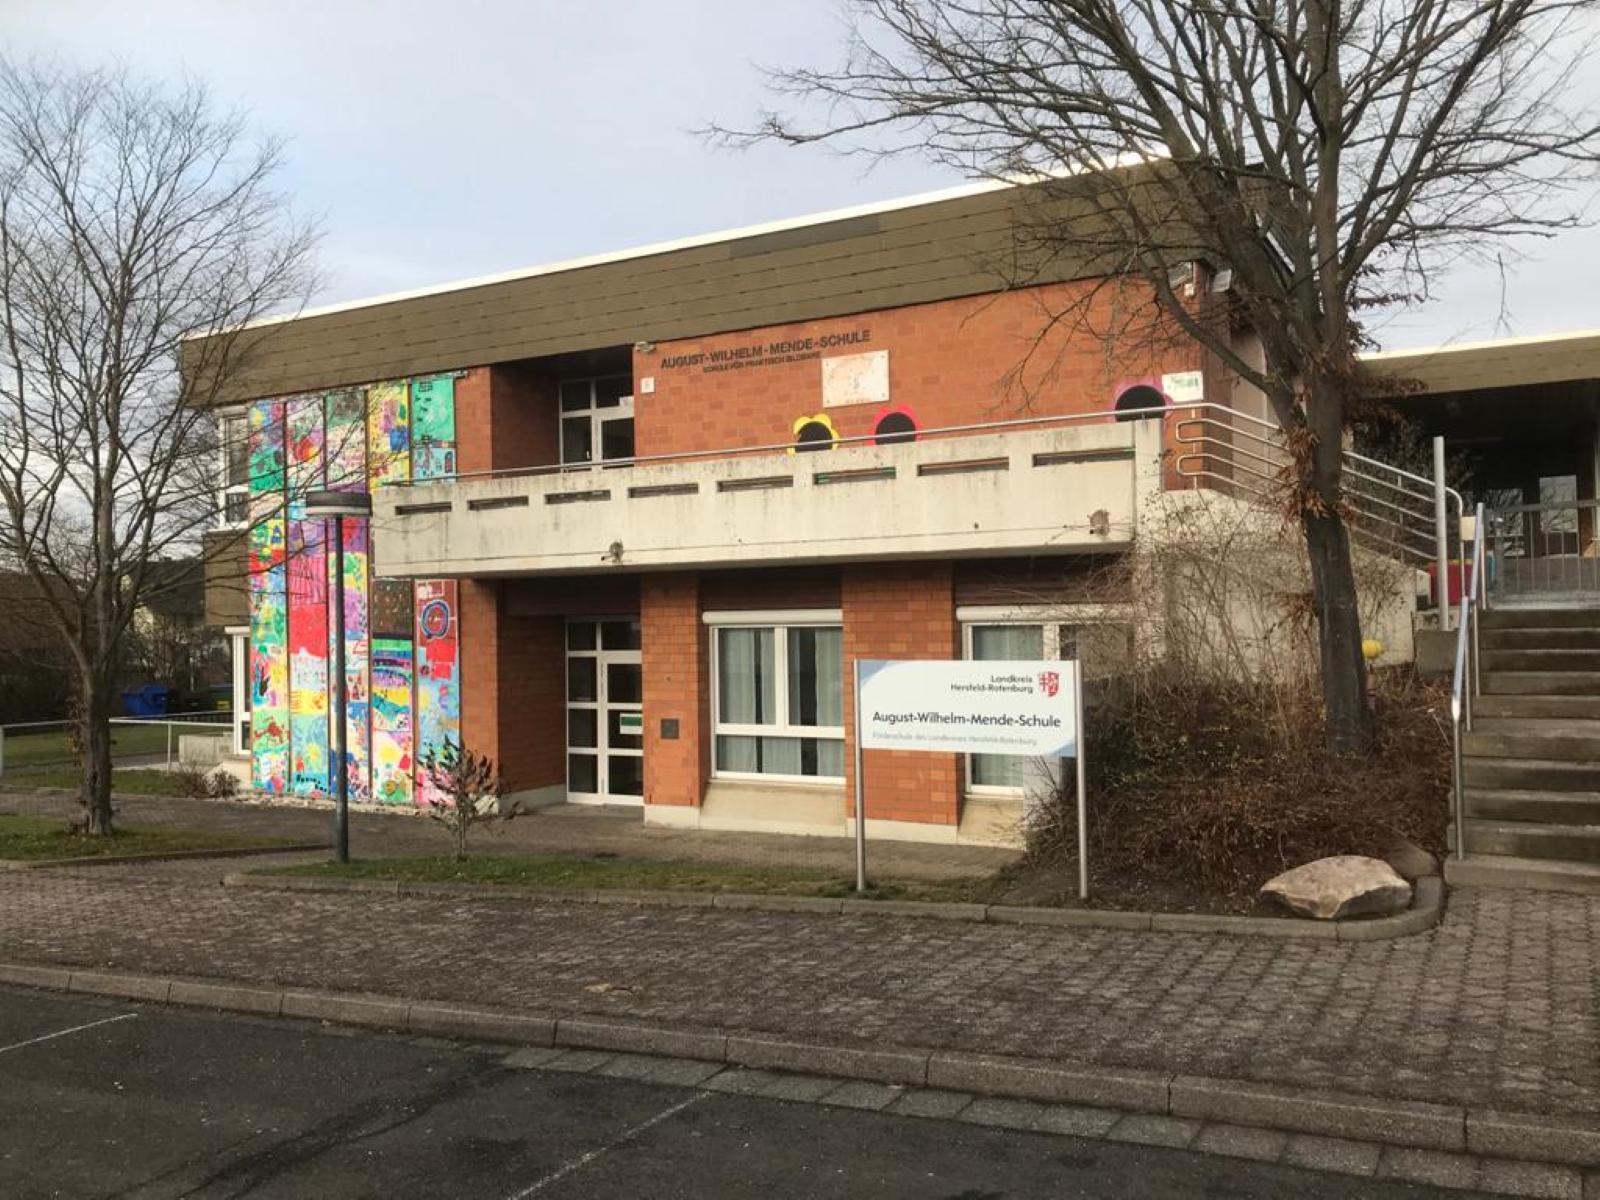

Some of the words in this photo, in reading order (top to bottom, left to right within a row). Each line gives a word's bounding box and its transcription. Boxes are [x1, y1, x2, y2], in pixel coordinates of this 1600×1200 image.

[661, 329, 870, 369] AUGUST-WILHELM-MENDE-SCHULE
[991, 675, 1033, 683] Landkreis
[950, 683, 1034, 694] Hersfeld-Rotenburg
[872, 711, 1062, 727] August-Wilhelm-Mende-Schule
